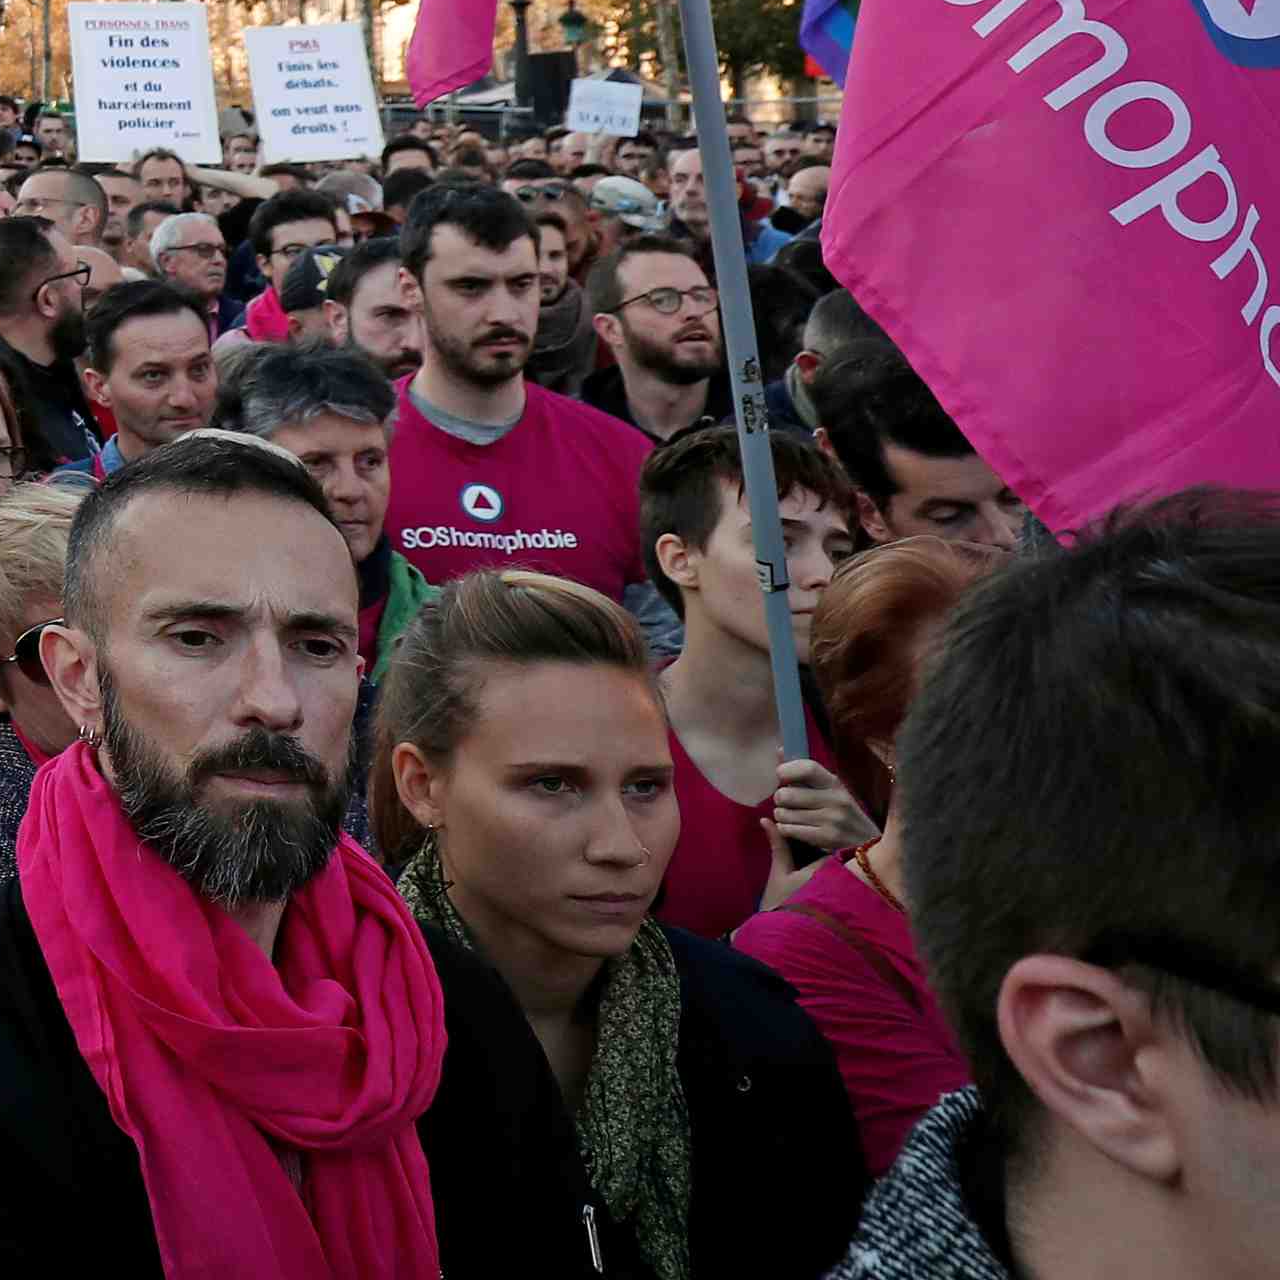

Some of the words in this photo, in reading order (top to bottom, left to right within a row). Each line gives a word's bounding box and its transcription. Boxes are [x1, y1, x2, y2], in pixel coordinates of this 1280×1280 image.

[109, 35, 134, 48] Fin
[140, 35, 170, 48] des
[101, 56, 180, 69] violences
[125, 82, 138, 93] et
[144, 80, 162, 92] du
[118, 117, 175, 131] policier
